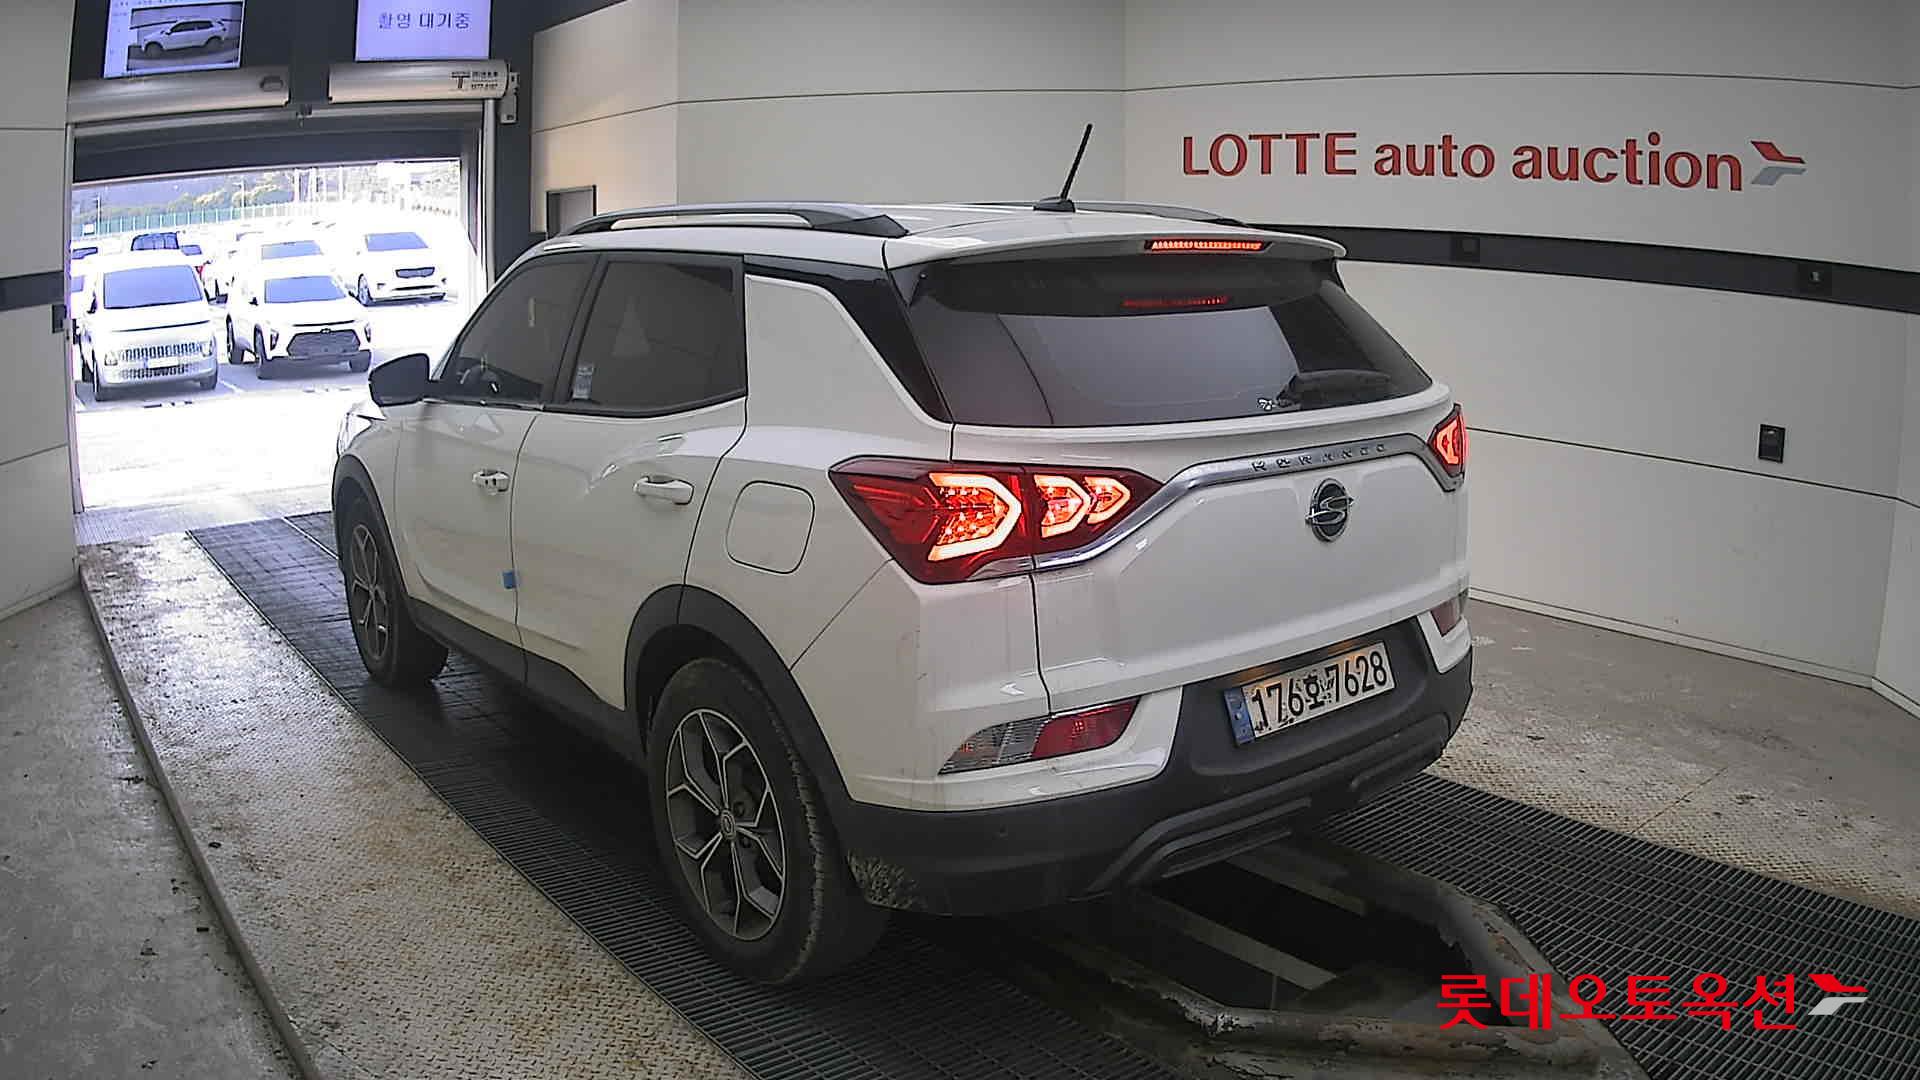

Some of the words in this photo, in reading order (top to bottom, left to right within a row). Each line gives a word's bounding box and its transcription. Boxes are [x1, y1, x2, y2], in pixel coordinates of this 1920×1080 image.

[418, 11, 471, 29] 대기중
[1183, 132, 1358, 177] LOTTE
[1374, 134, 1496, 178] auto
[1513, 131, 1743, 191] auction
